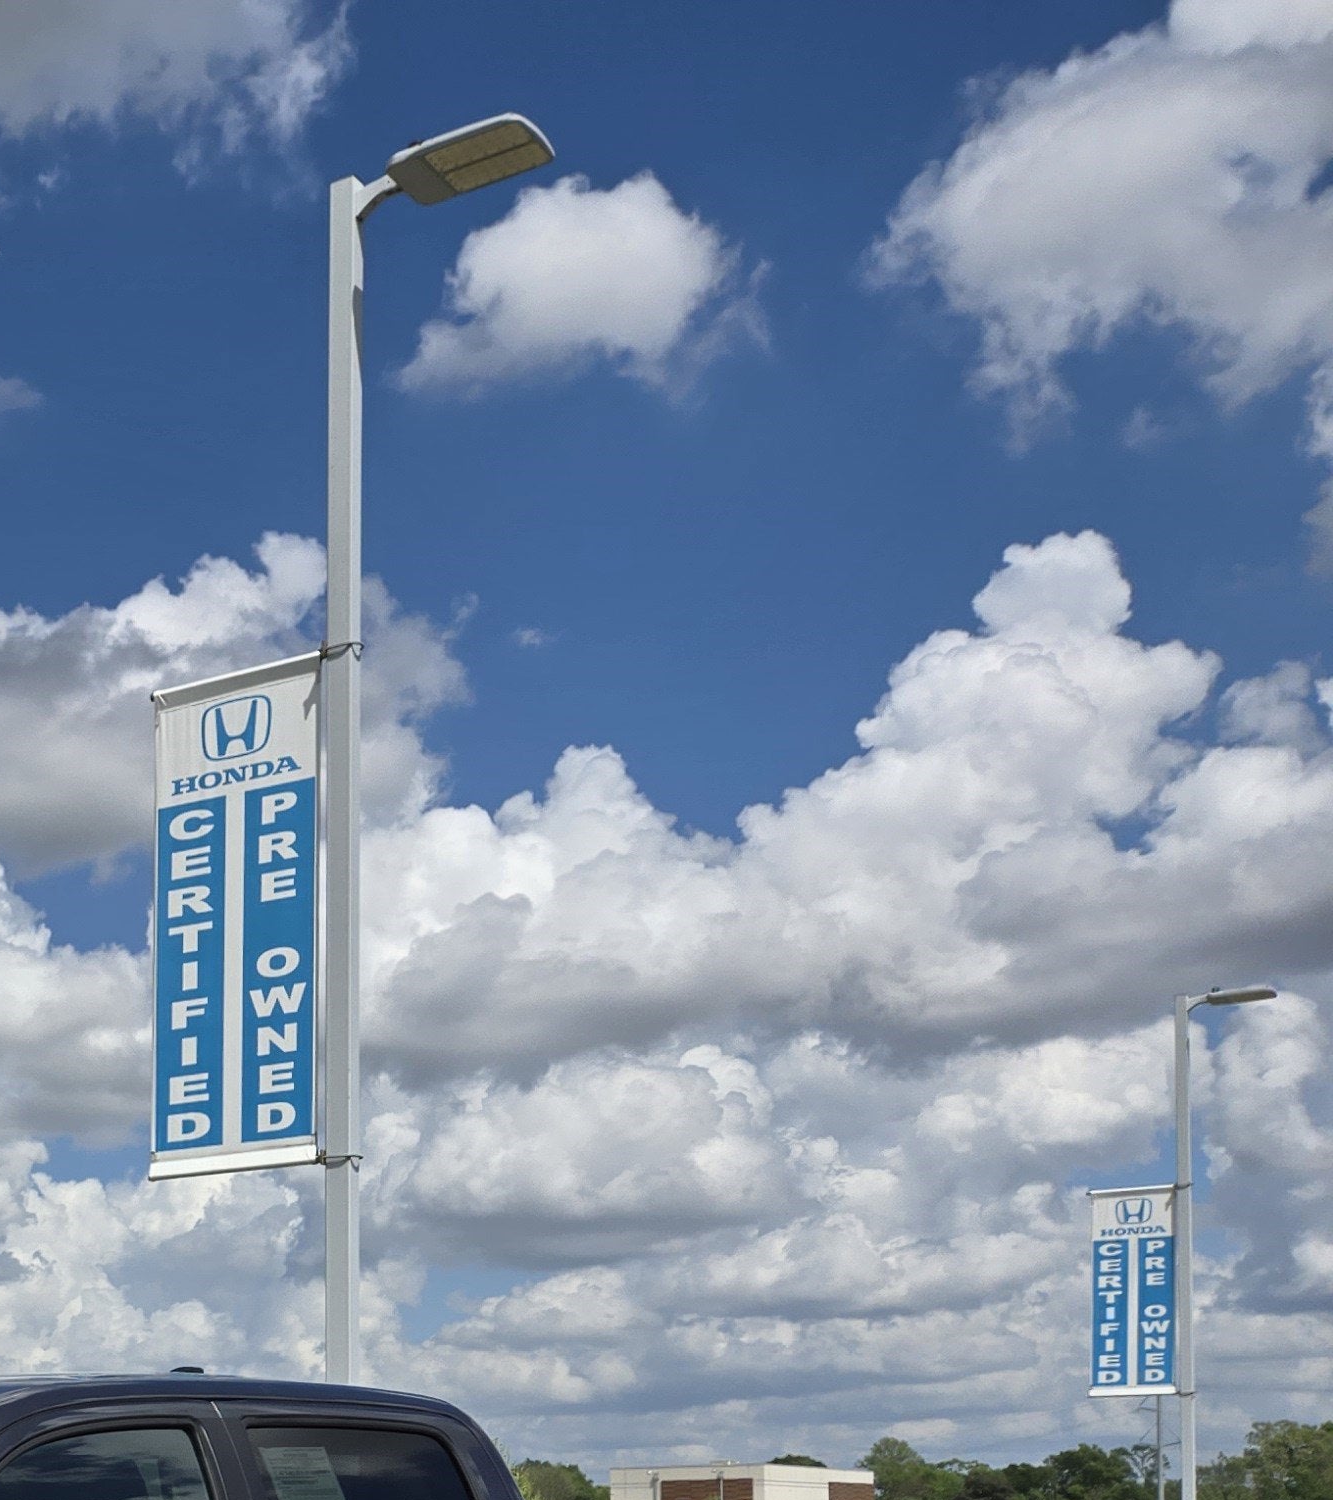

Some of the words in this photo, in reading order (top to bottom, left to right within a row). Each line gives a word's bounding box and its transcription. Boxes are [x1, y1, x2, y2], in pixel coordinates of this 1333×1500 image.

[171, 755, 301, 796] HONDA
[257, 791, 300, 904] PRE
[166, 808, 215, 1144] CERTIFIED
[249, 945, 307, 1134] OWNED
[1100, 1225, 1166, 1237] HONDA
[1144, 1240, 1166, 1286] PRE
[1097, 1243, 1123, 1384] CERTIFIED
[1140, 1304, 1170, 1382] OWNED
